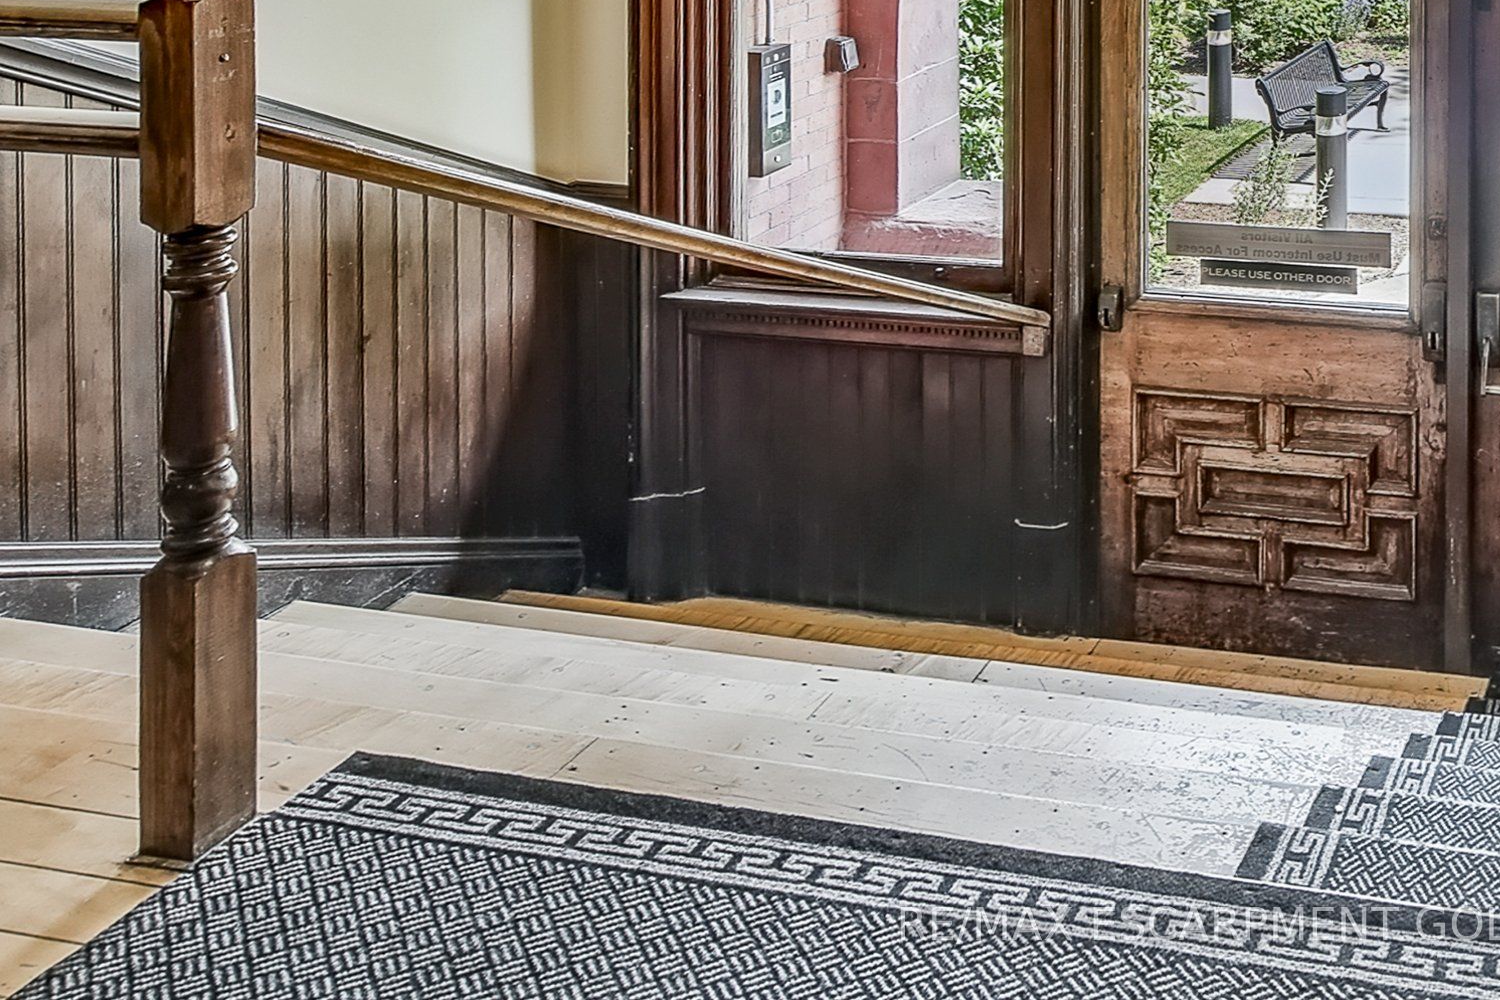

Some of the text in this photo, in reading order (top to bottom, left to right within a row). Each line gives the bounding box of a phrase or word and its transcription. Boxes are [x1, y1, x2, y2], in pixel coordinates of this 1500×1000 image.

[1202, 266, 1351, 285] PLEASE USE OTHER DOOR
